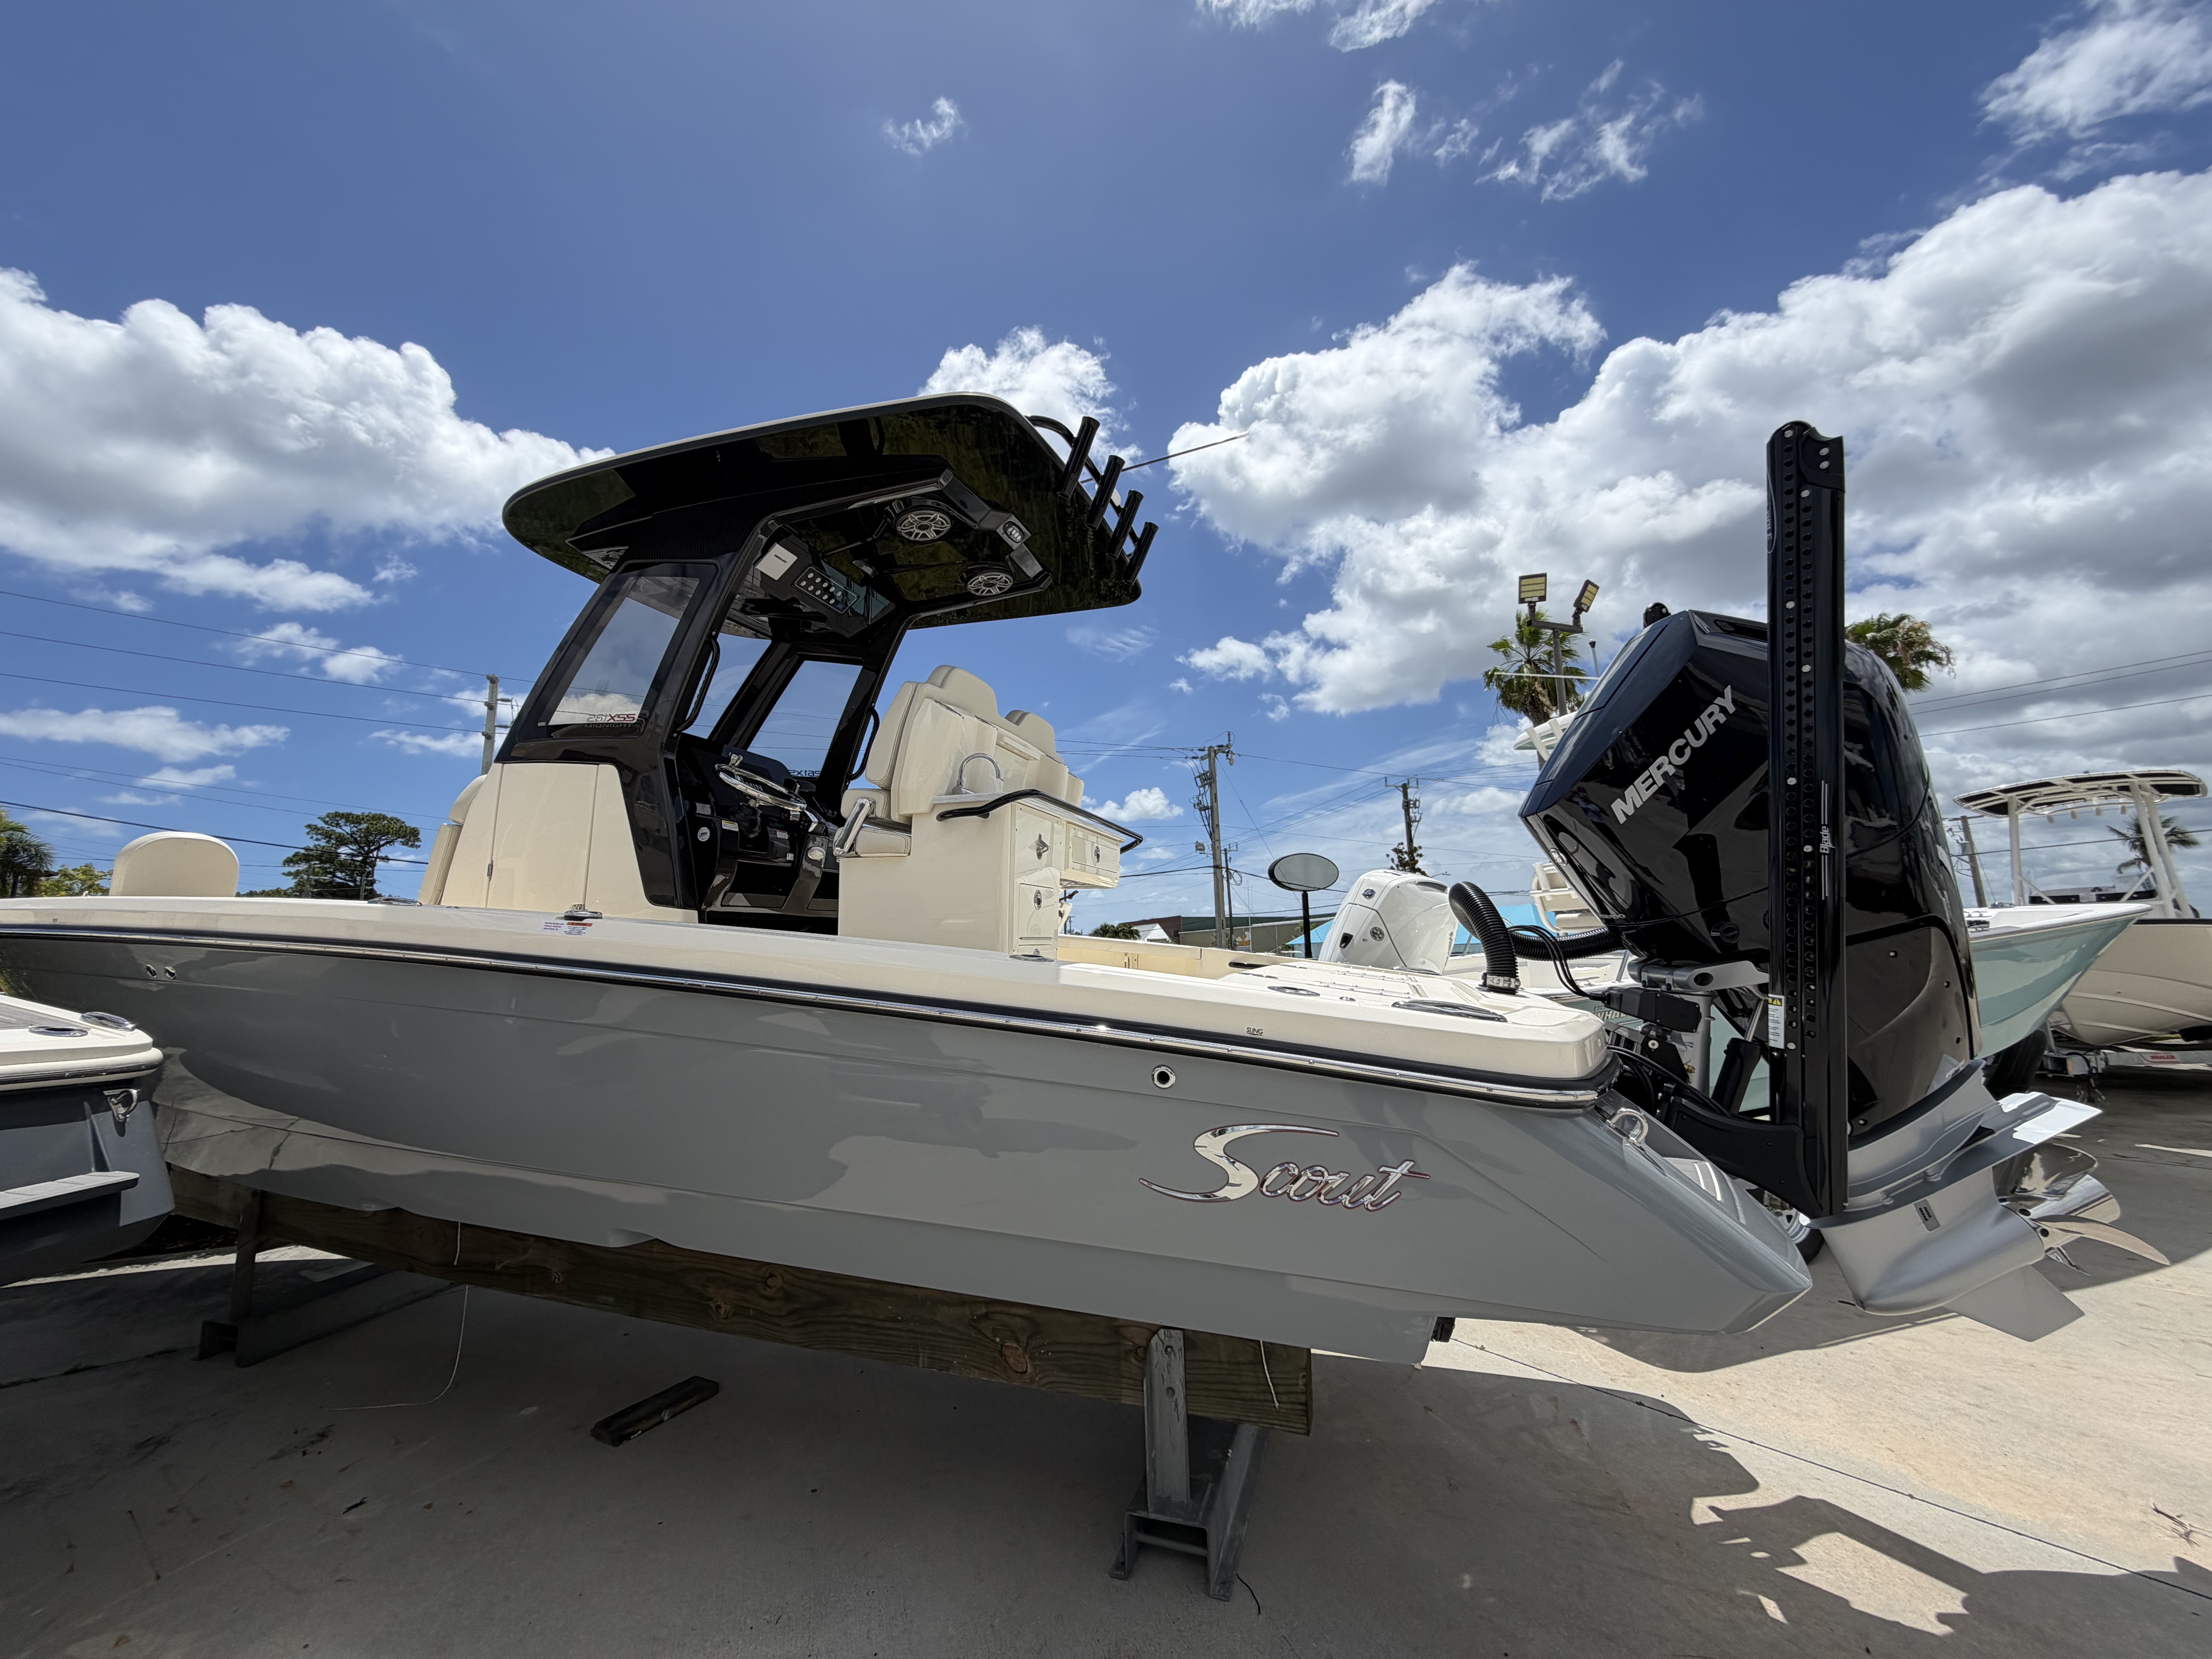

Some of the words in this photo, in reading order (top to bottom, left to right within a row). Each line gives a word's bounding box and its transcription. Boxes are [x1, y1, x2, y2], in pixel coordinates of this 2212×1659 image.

[586, 714, 636, 722] 261XSS
[1611, 685, 1736, 824] MERCURY
[1820, 826, 1835, 854] Blade
[1139, 1123, 1431, 1212] Scout
